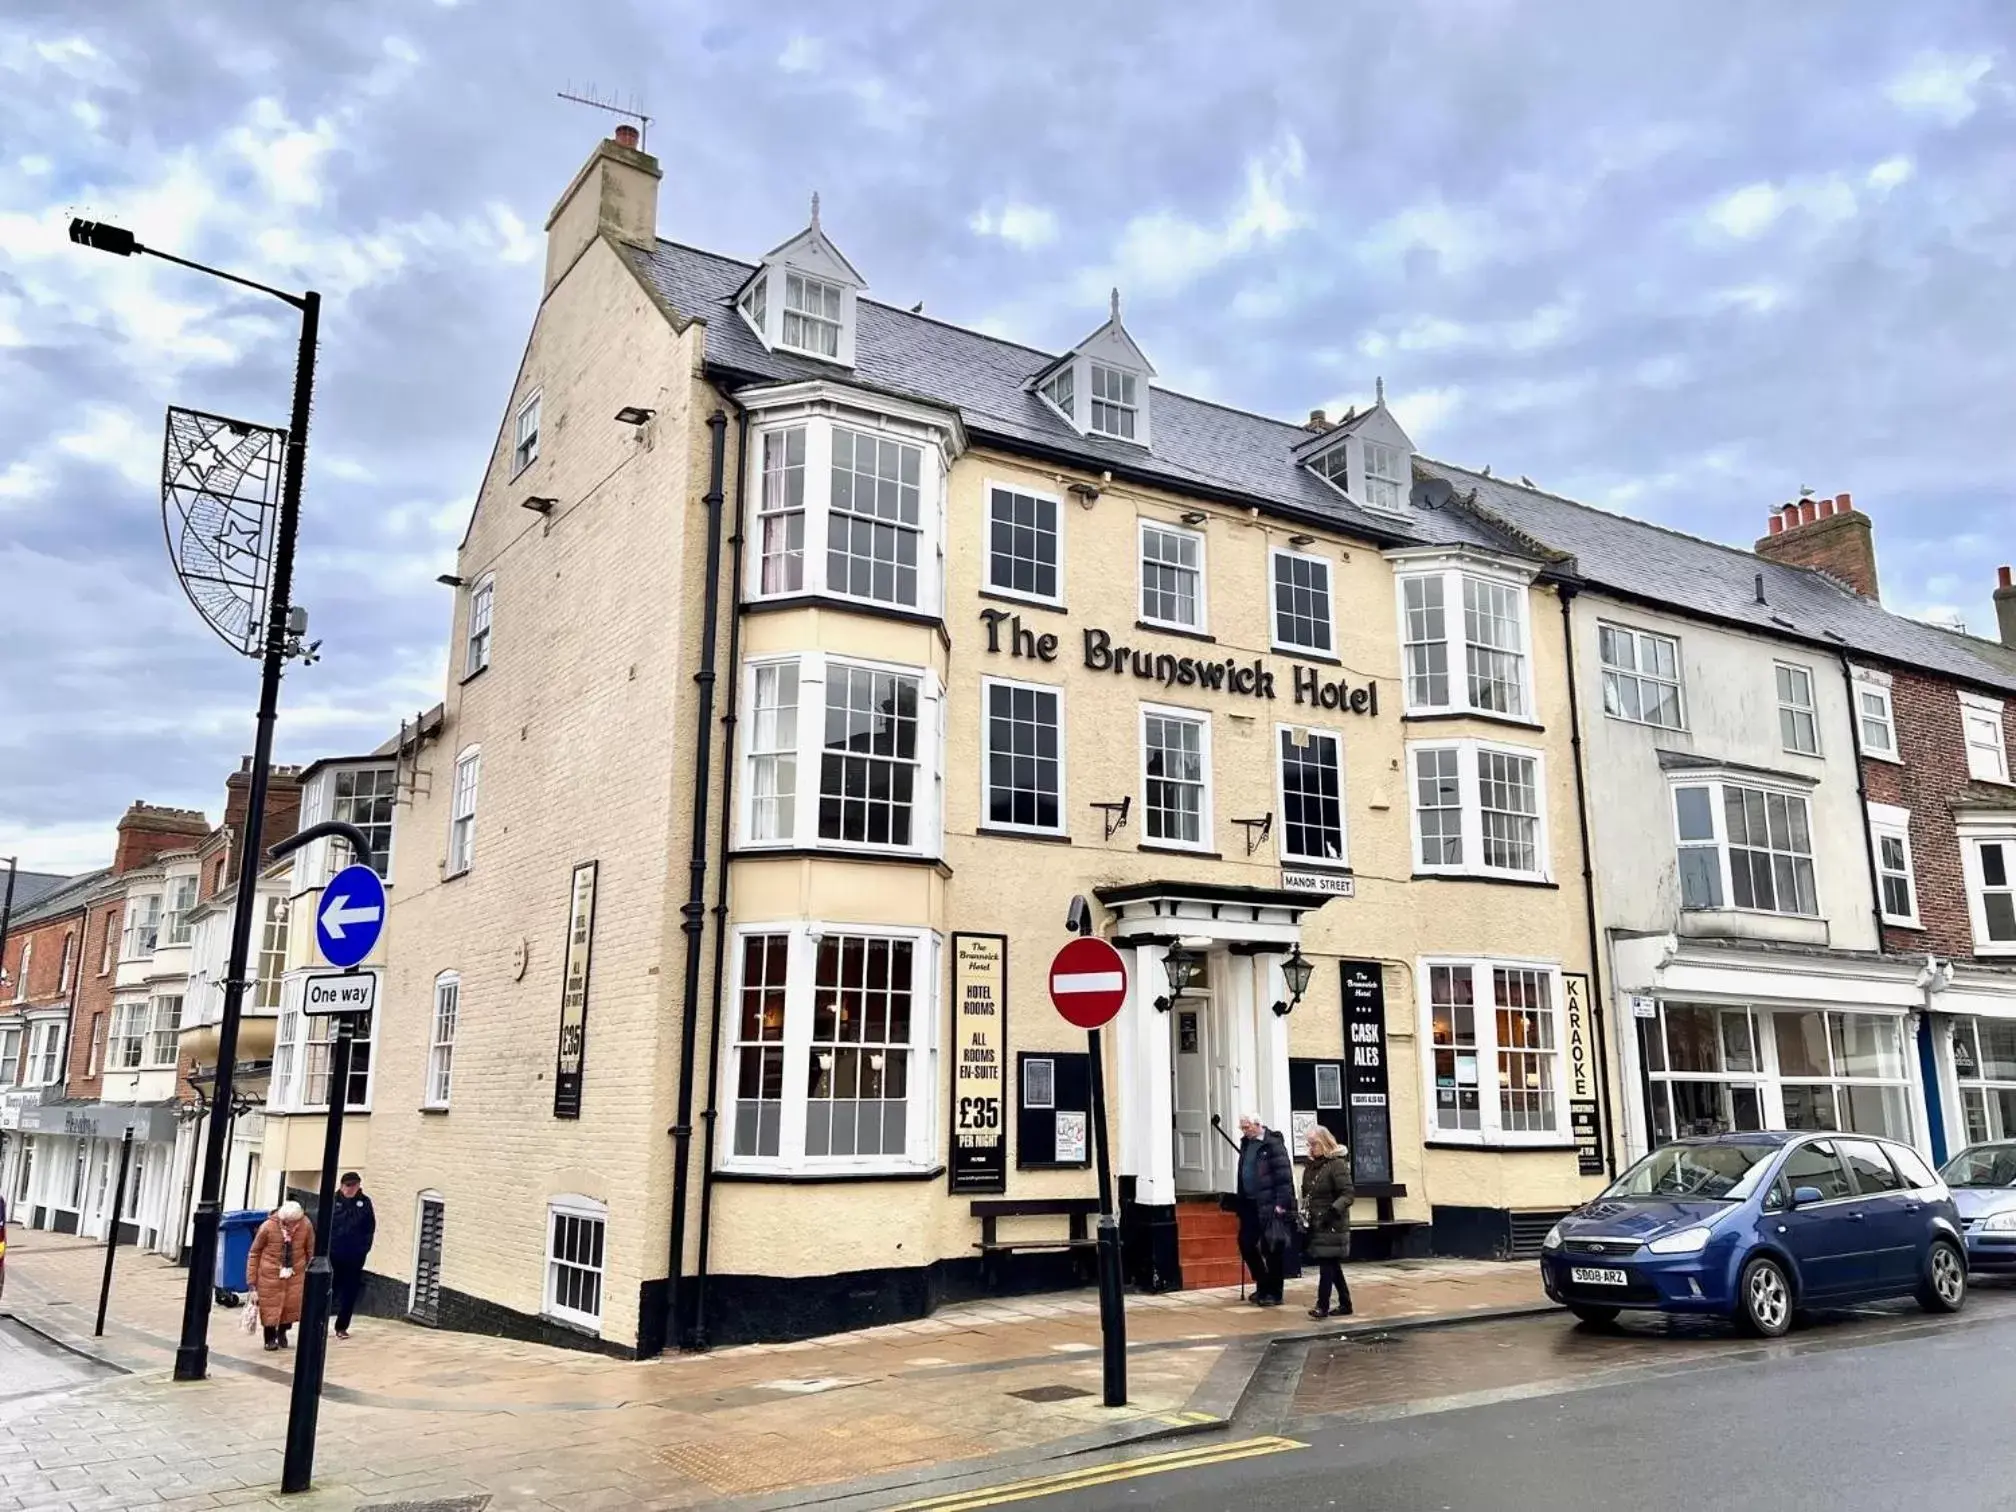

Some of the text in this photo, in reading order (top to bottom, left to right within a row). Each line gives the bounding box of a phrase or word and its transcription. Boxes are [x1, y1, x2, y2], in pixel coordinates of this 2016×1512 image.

[979, 607, 1379, 717] The Brunswick Hotel
[1285, 876, 1351, 892] MANOR STREET
[972, 942, 987, 952] The
[968, 961, 990, 971] Hotel
[311, 986, 369, 1004] One way
[966, 985, 992, 999] HOTEL
[963, 1001, 995, 1016] ROOMS
[562, 1024, 581, 1055] £35
[971, 1032, 987, 1046] ALL
[1351, 1023, 1379, 1043] CASK
[1567, 980, 1587, 1095] KARAOKE
[963, 1048, 995, 1063] ROOMS
[1354, 1047, 1379, 1066] ALES
[959, 1065, 999, 1080] EN-SUITE
[958, 1097, 999, 1129] £35
[958, 1134, 998, 1148] PER NIGHT
[1575, 1268, 1624, 1283] SD08 ARZ
